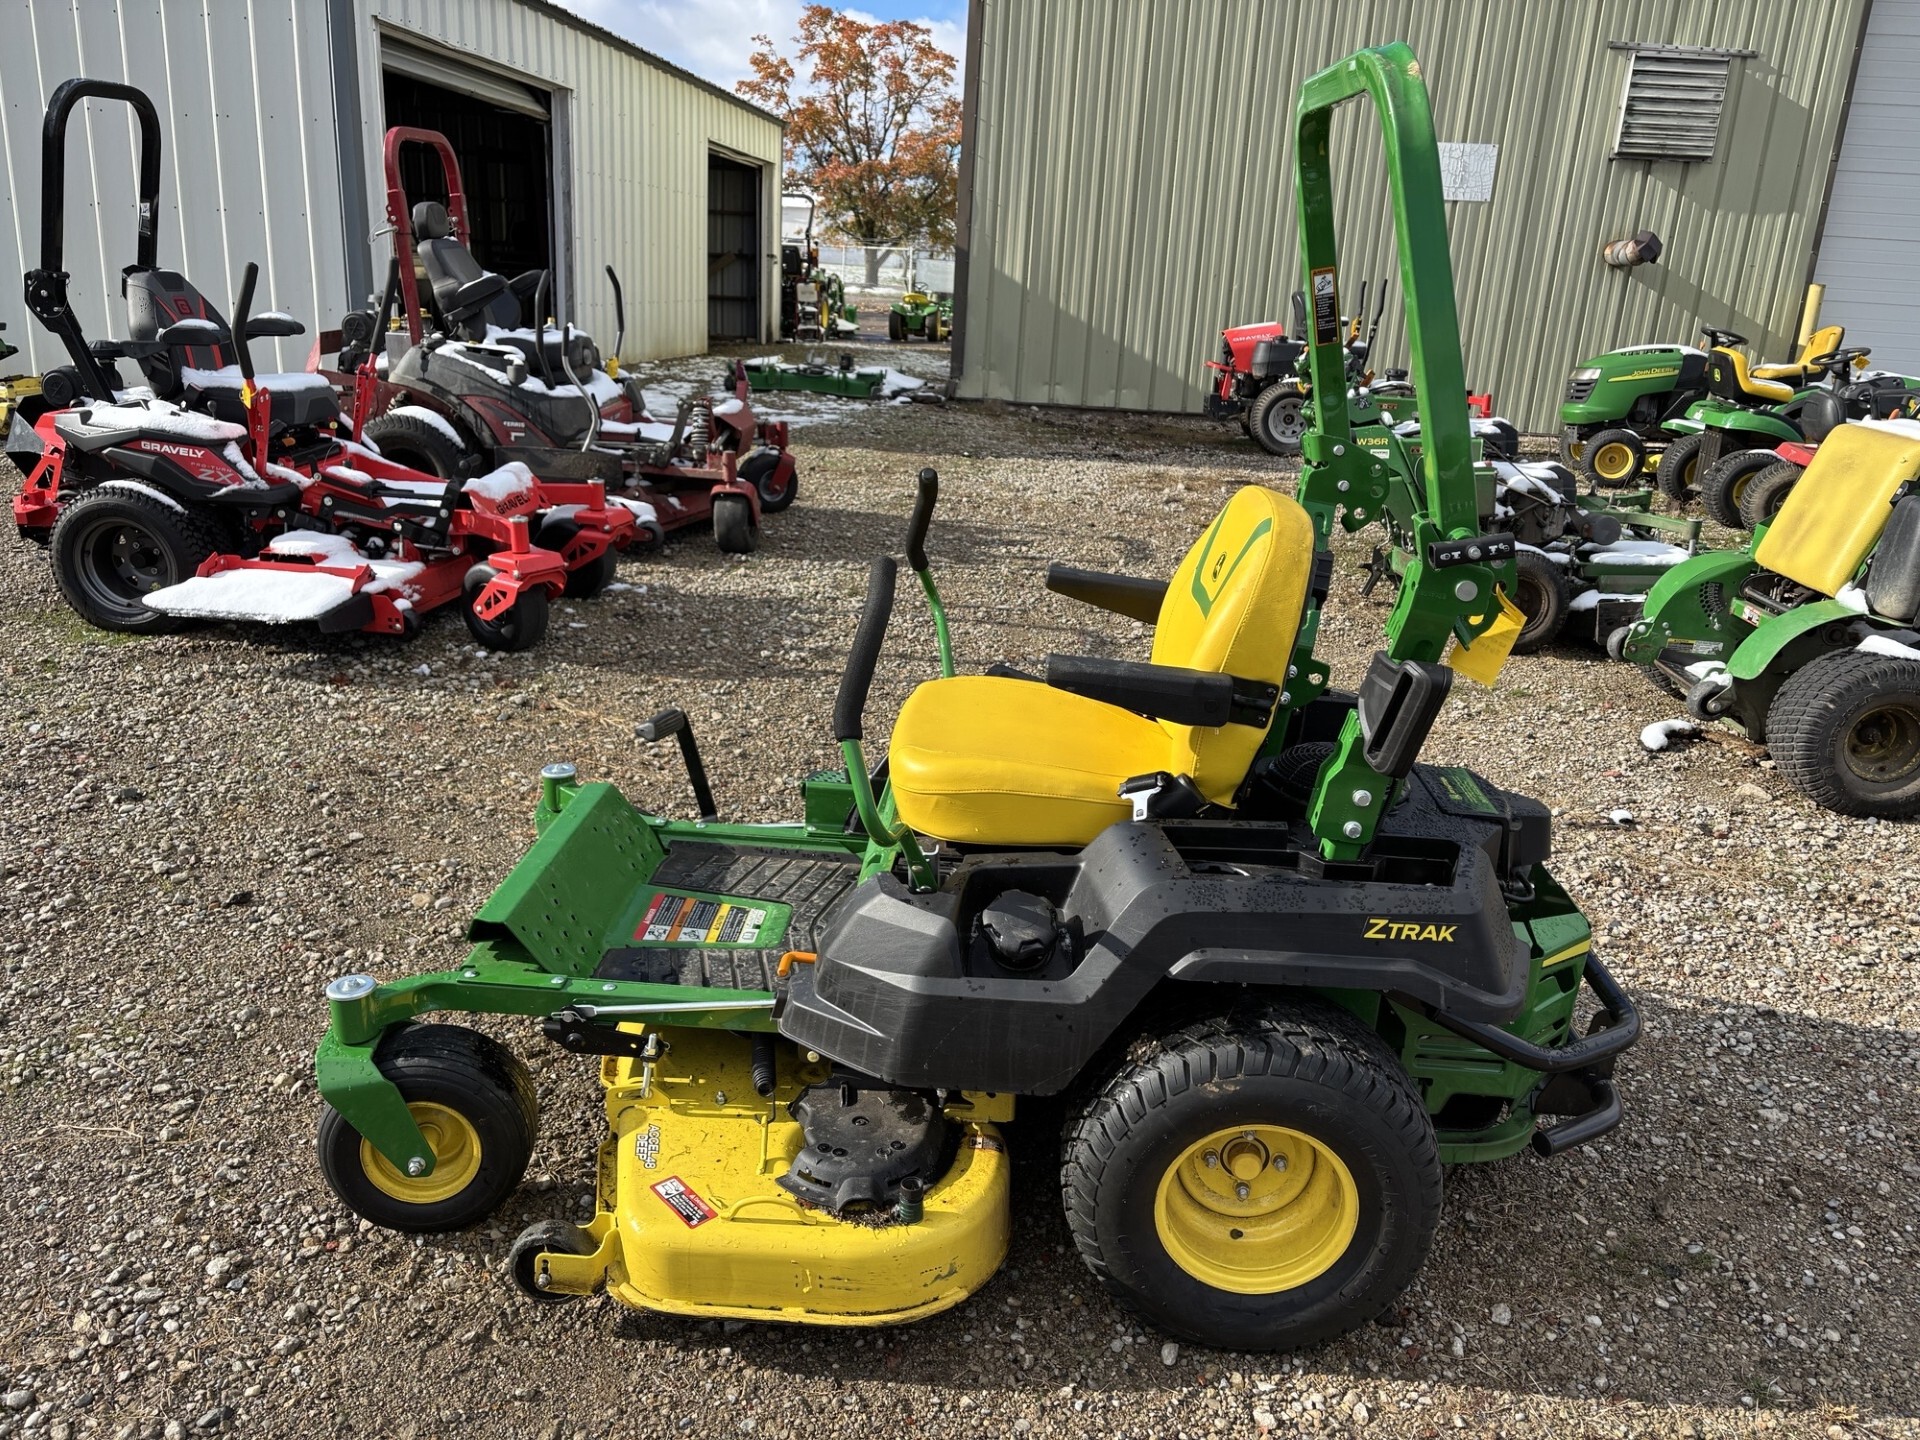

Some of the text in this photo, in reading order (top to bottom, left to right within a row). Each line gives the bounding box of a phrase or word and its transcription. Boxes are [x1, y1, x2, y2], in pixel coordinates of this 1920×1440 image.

[1232, 333, 1271, 343] GRAVELY
[140, 441, 205, 458] GRAVELY
[1356, 437, 1389, 446] W36R
[197, 469, 234, 485] ZX
[1363, 918, 1458, 942] ZTRAK
[635, 1133, 649, 1161] DEEP
